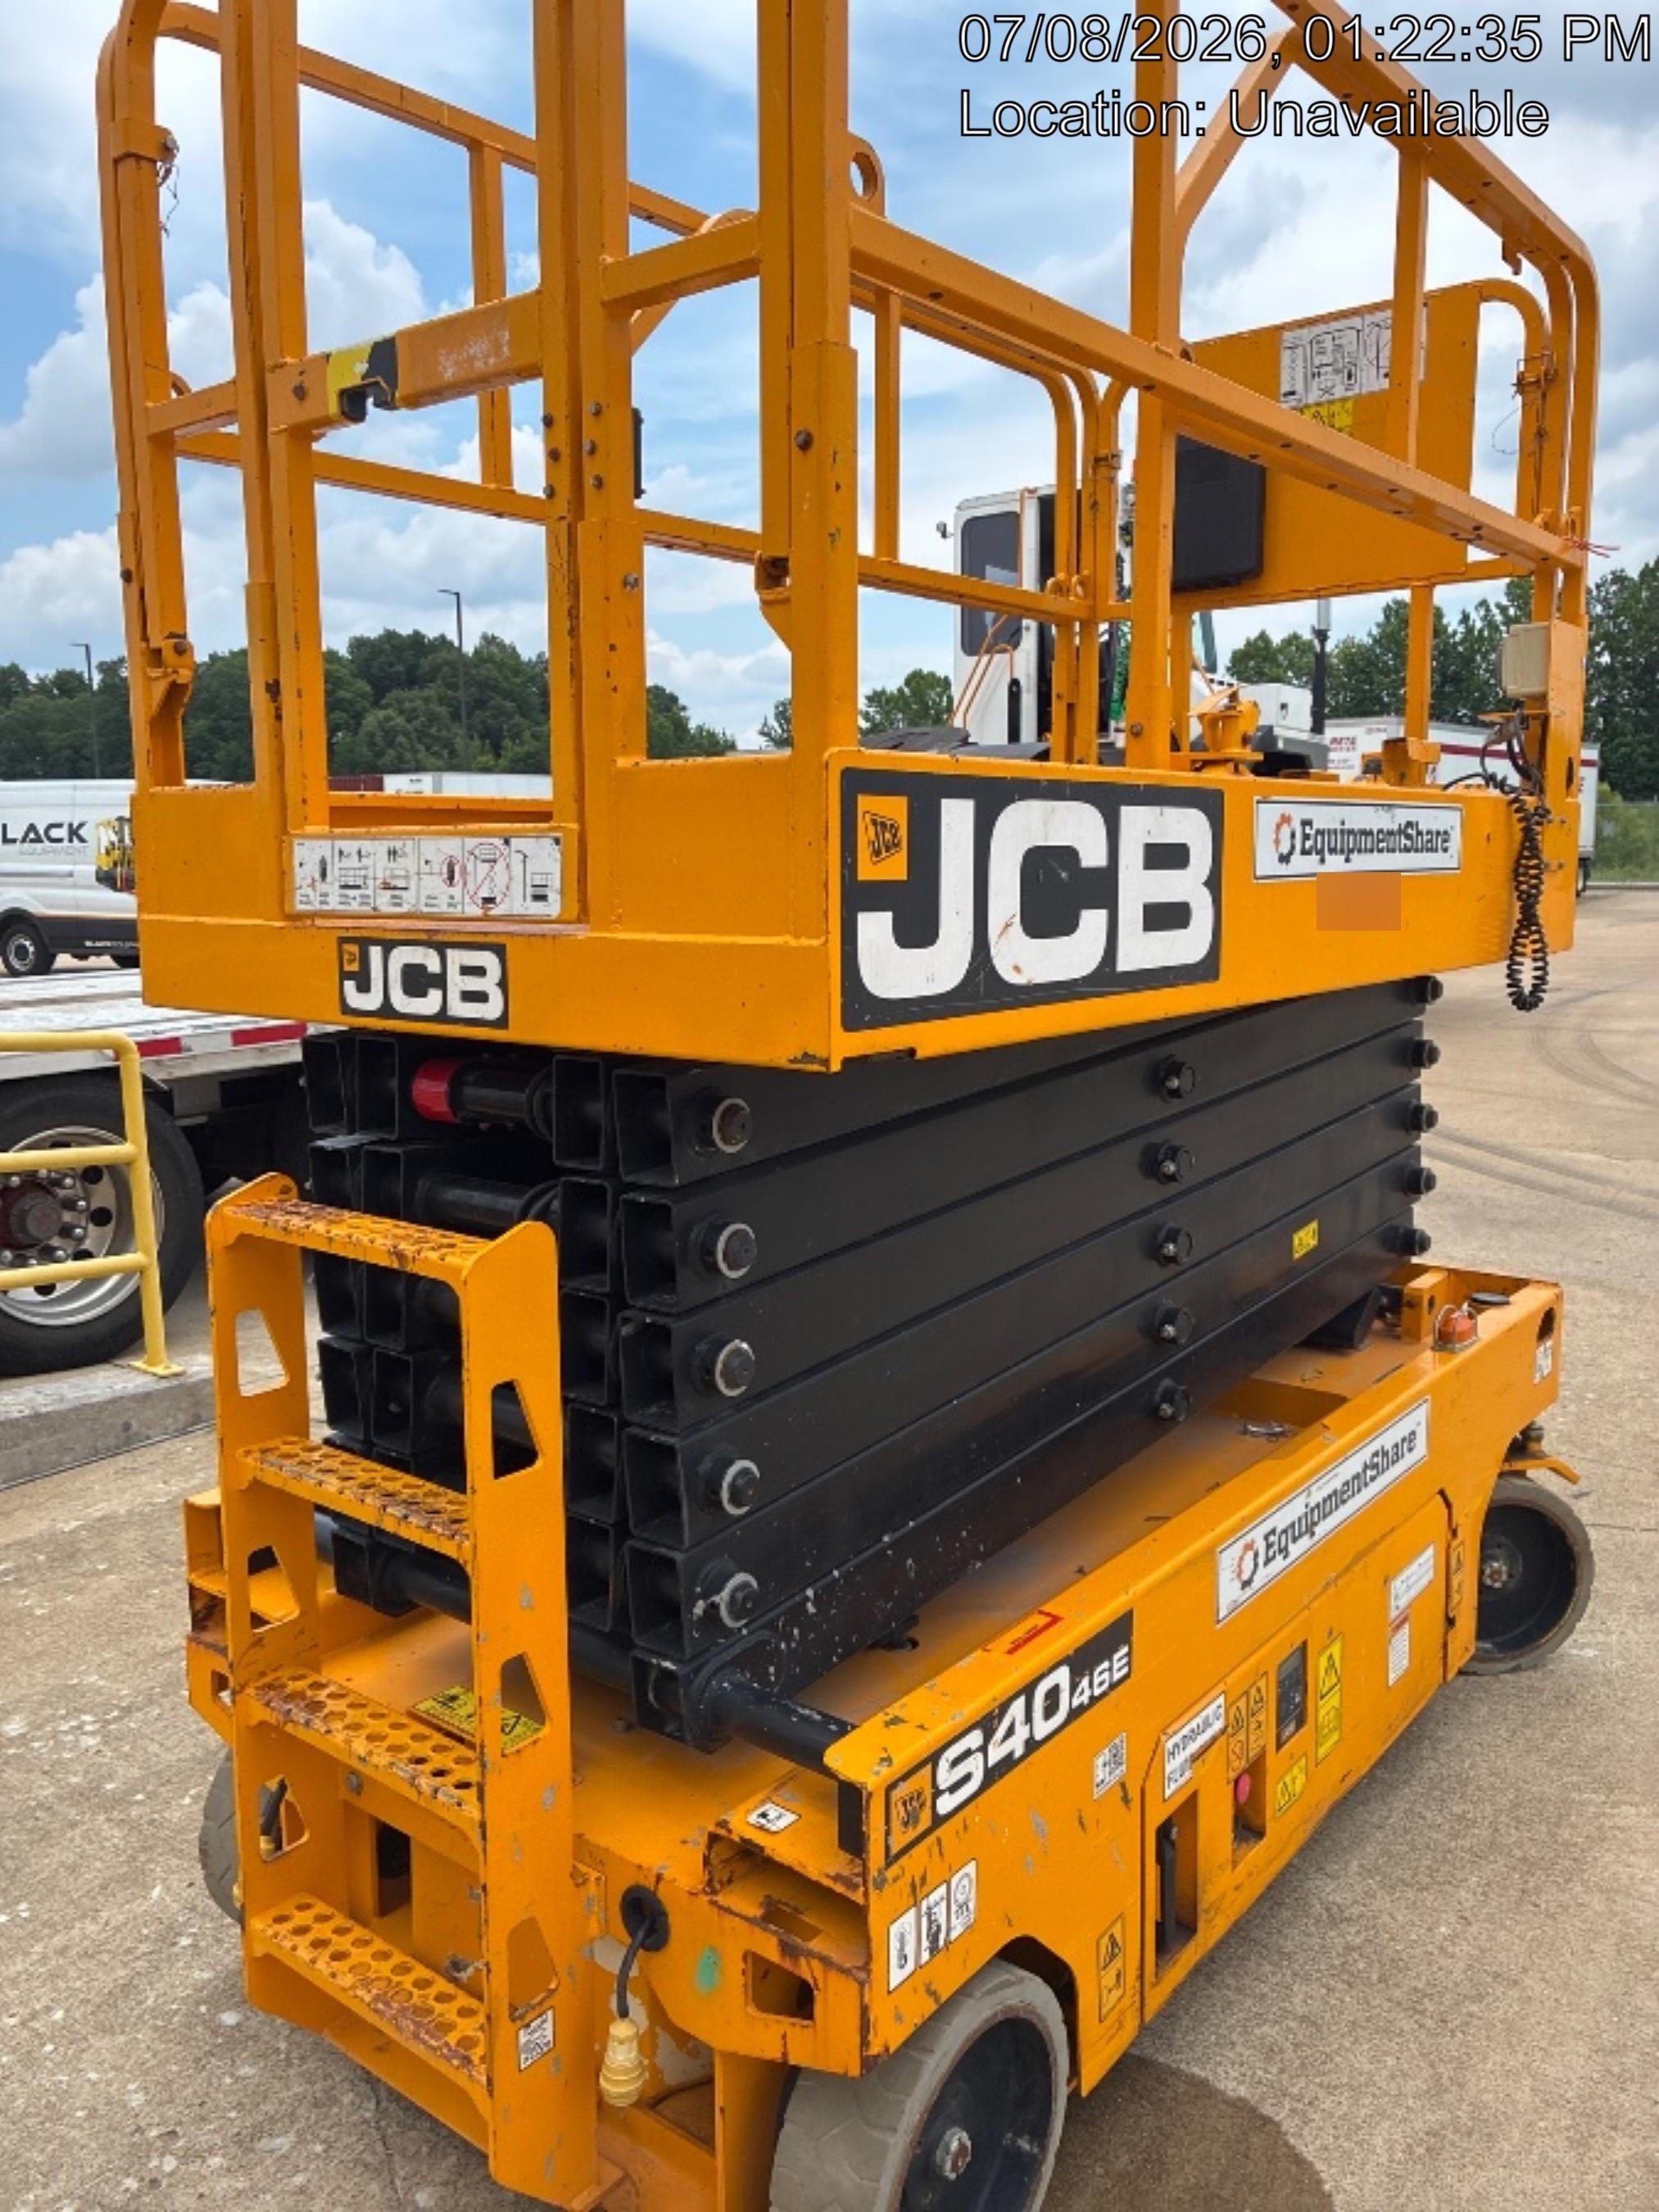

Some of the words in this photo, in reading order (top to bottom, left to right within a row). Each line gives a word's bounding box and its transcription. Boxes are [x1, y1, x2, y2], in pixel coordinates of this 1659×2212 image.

[1299, 818, 1451, 865] EquipmentShare
[858, 798, 1214, 999] JCB
[343, 945, 504, 1021] JCB
[1263, 1429, 1416, 1568] EquipmentShare
